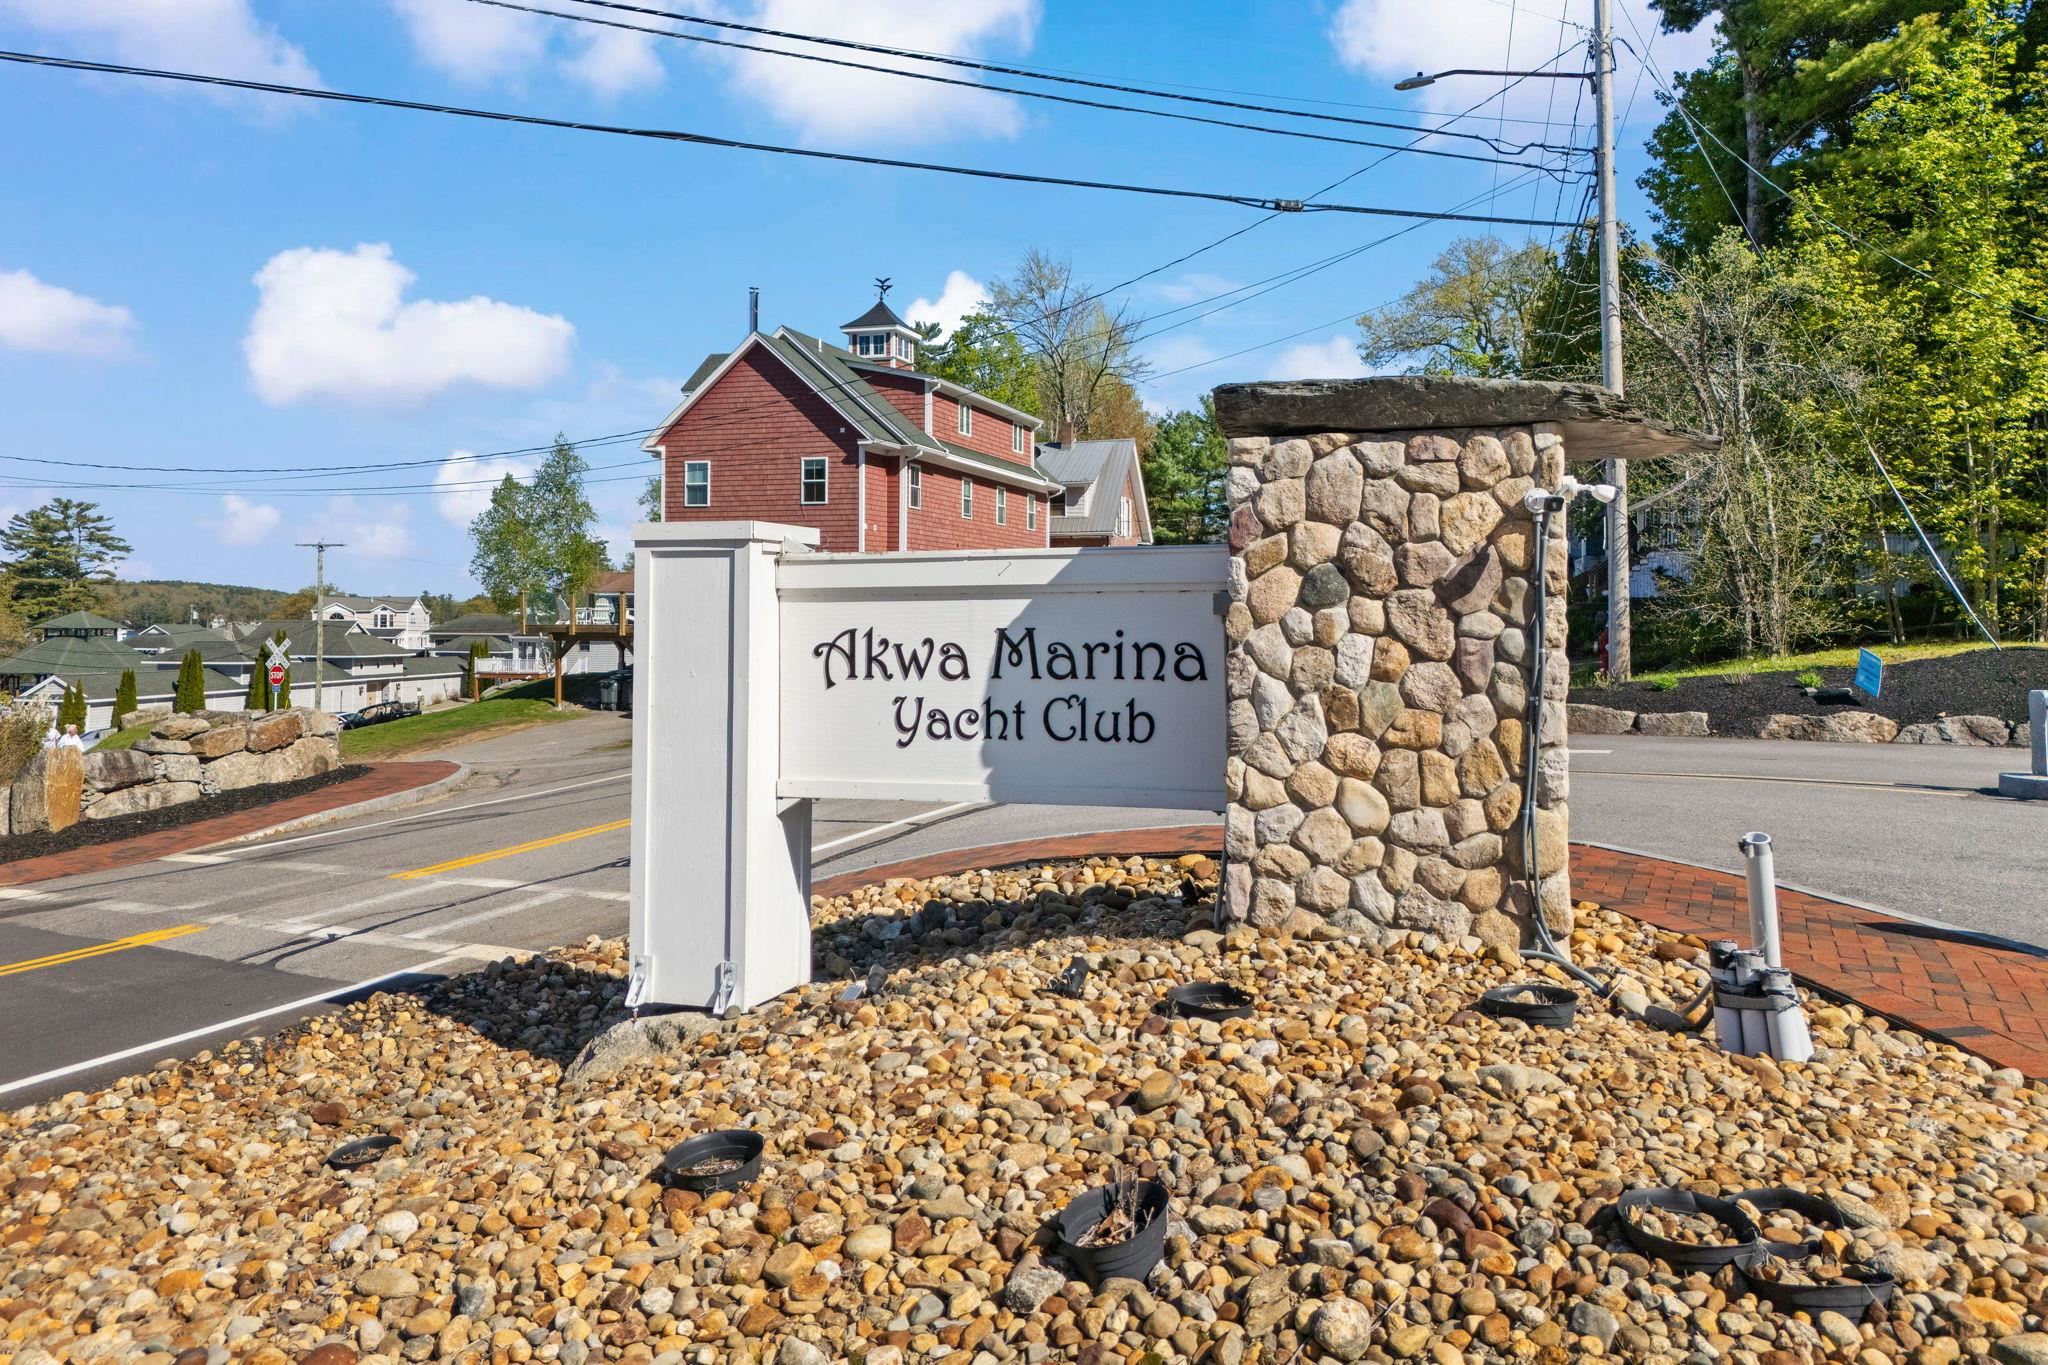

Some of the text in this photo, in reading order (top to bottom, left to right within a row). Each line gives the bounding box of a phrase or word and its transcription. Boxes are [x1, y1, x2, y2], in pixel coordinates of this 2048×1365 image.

[270, 671, 284, 679] STOP
[812, 626, 1211, 689] Akwa Marina
[892, 694, 1157, 748] Yacht Club
